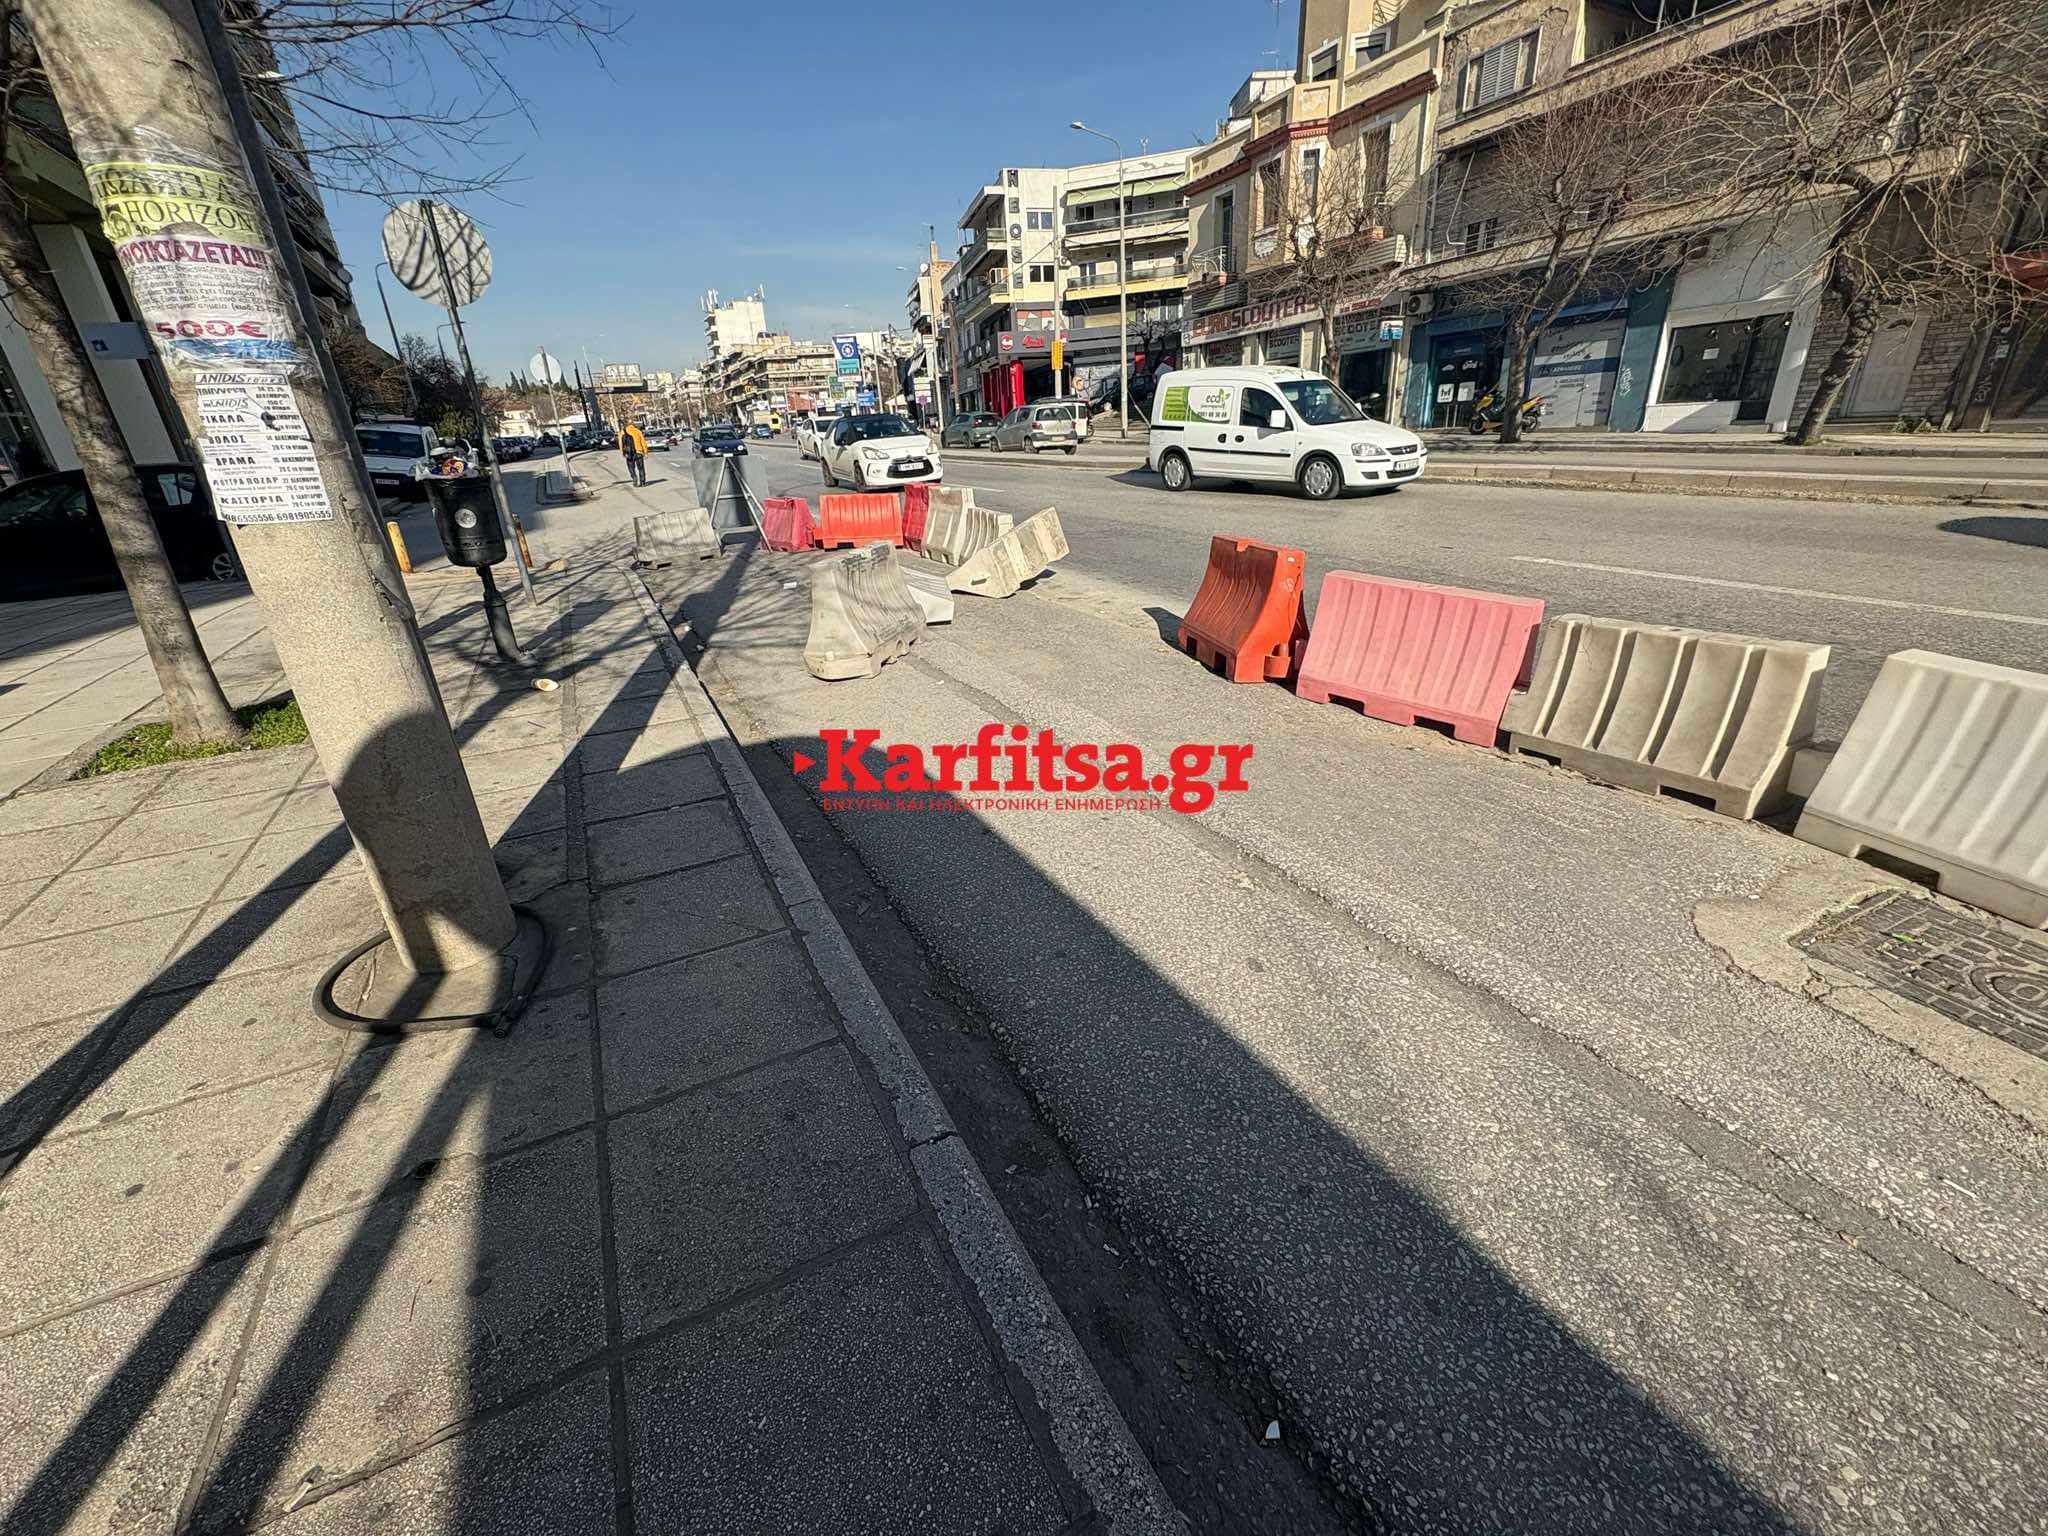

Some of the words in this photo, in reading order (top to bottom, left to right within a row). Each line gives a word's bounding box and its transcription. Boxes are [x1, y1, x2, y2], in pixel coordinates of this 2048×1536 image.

[123, 200, 254, 232] HORIZON
[155, 320, 267, 340] 500€
[200, 374, 247, 384] ANIDIS
[215, 456, 256, 466] ΔΡΑΜΑ
[220, 495, 284, 505] ΚΑΣΤΟΡΙΑ
